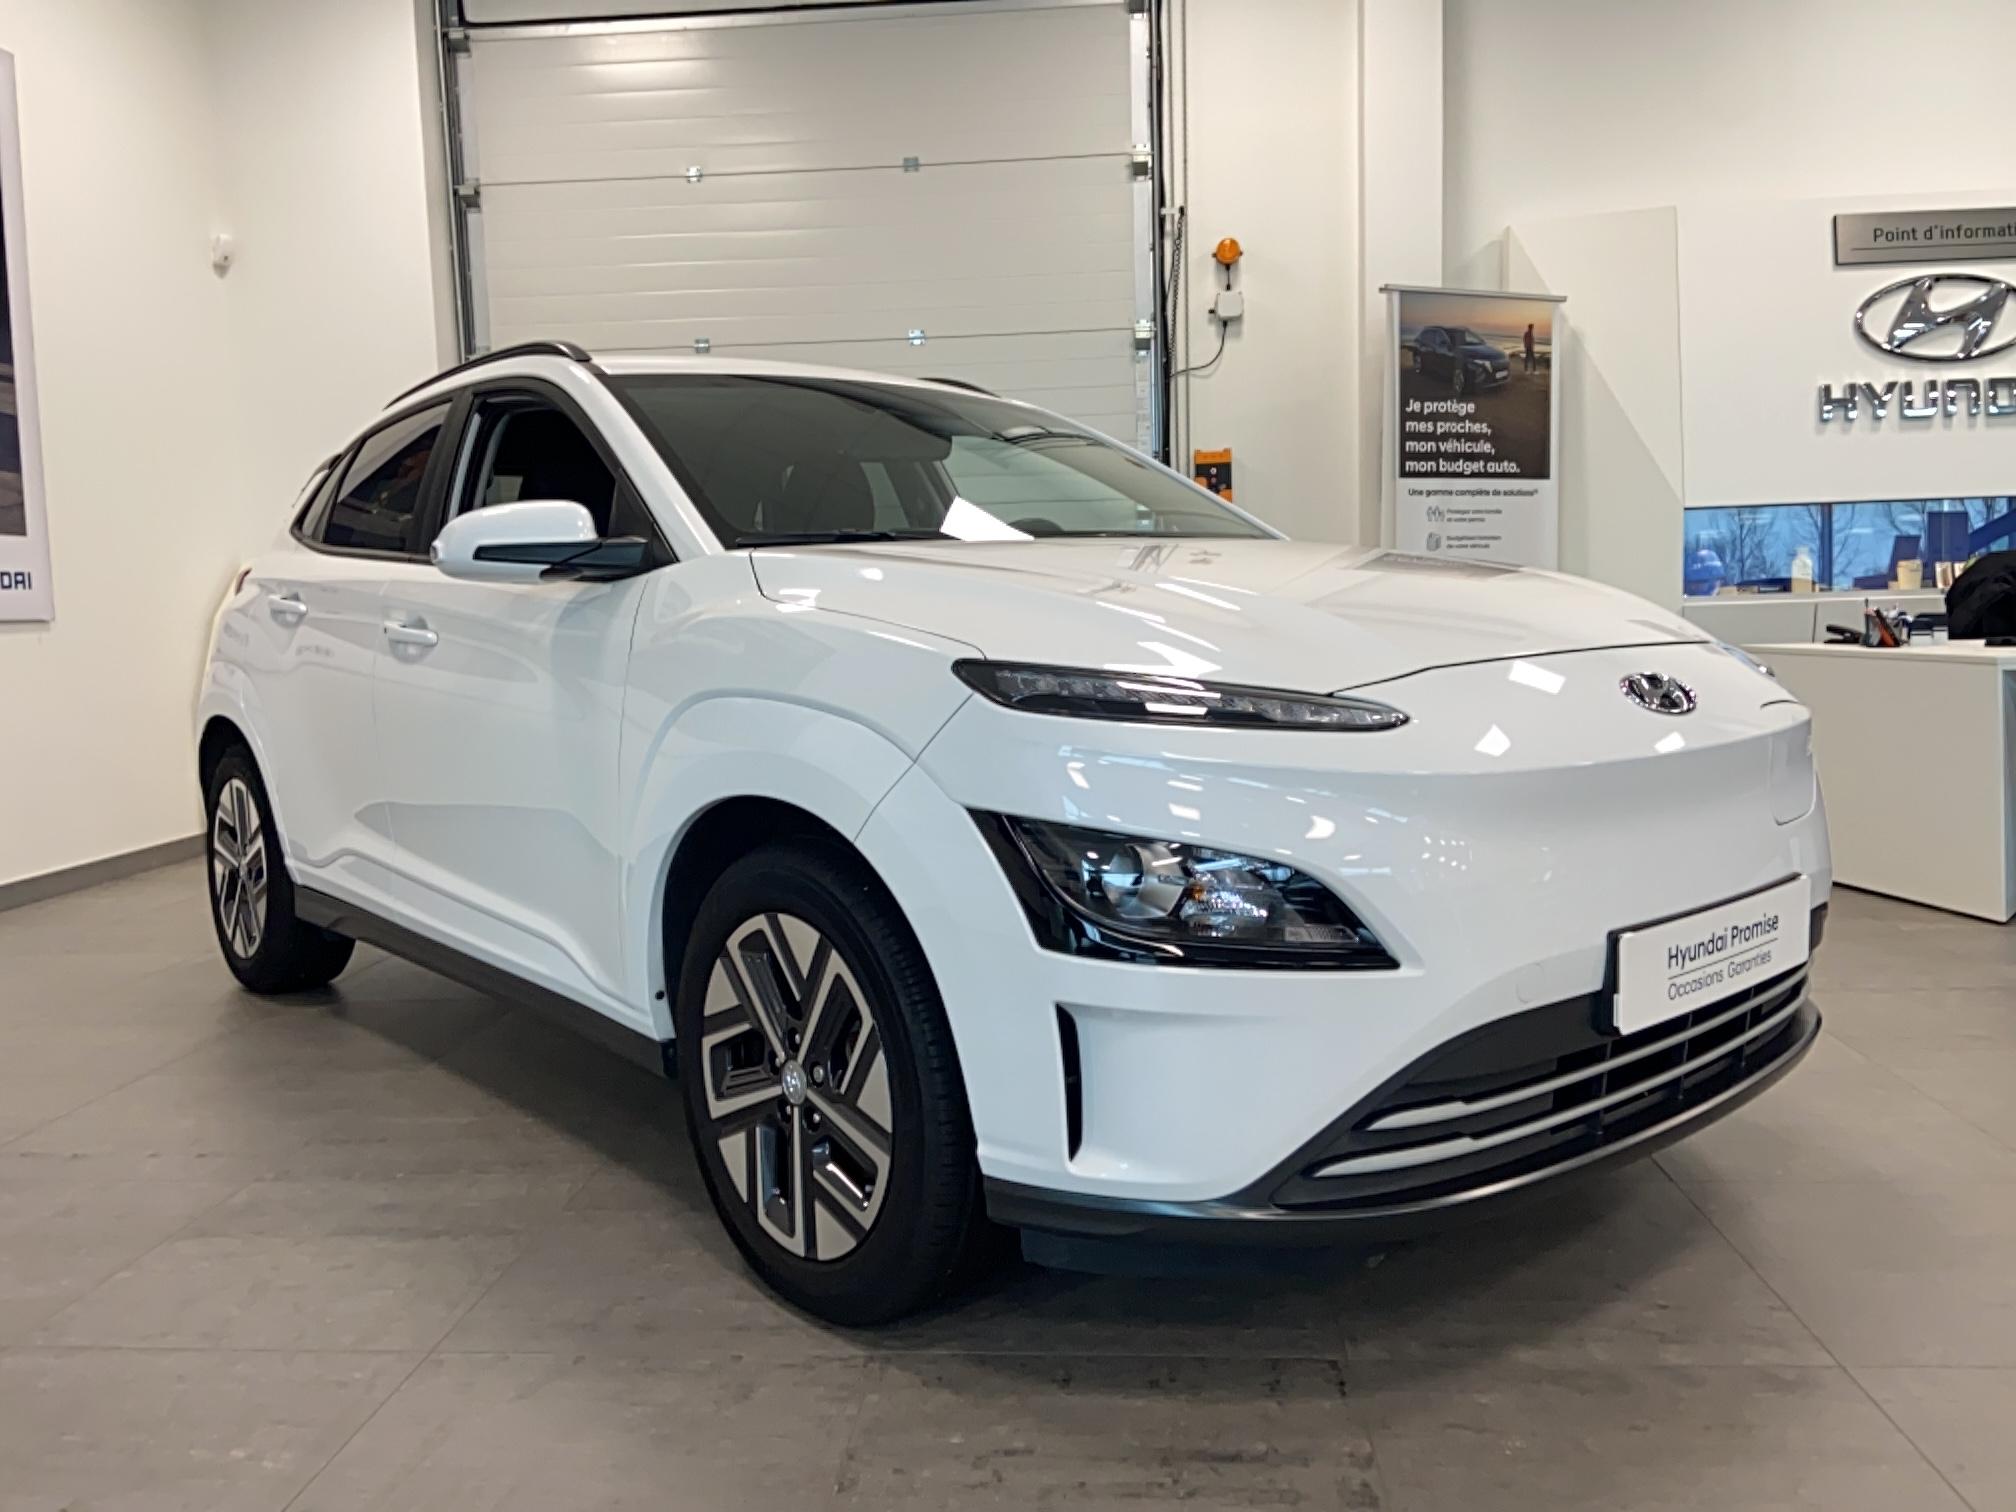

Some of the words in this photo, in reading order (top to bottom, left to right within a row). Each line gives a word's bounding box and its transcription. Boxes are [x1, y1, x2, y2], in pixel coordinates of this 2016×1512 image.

[1873, 226, 1918, 243] Point
[1405, 399, 1421, 413] Je
[1424, 398, 1475, 416] protège
[1405, 420, 1434, 433] mes
[1437, 419, 1492, 437] proches,
[1405, 440, 1436, 453] mon
[1438, 438, 1495, 456] véhicule,
[1405, 460, 1436, 473] mon
[1439, 459, 1485, 476] budget
[1487, 460, 1521, 473] auto.
[1408, 488, 1424, 496] Une
[1425, 489, 1453, 498] gamme
[0, 571, 32, 591] DAI
[1668, 927, 1728, 970] Hyundai
[1731, 913, 1779, 947] Promise
[1668, 967, 1724, 1001] Occasions
[1727, 949, 1772, 979] Garanties
